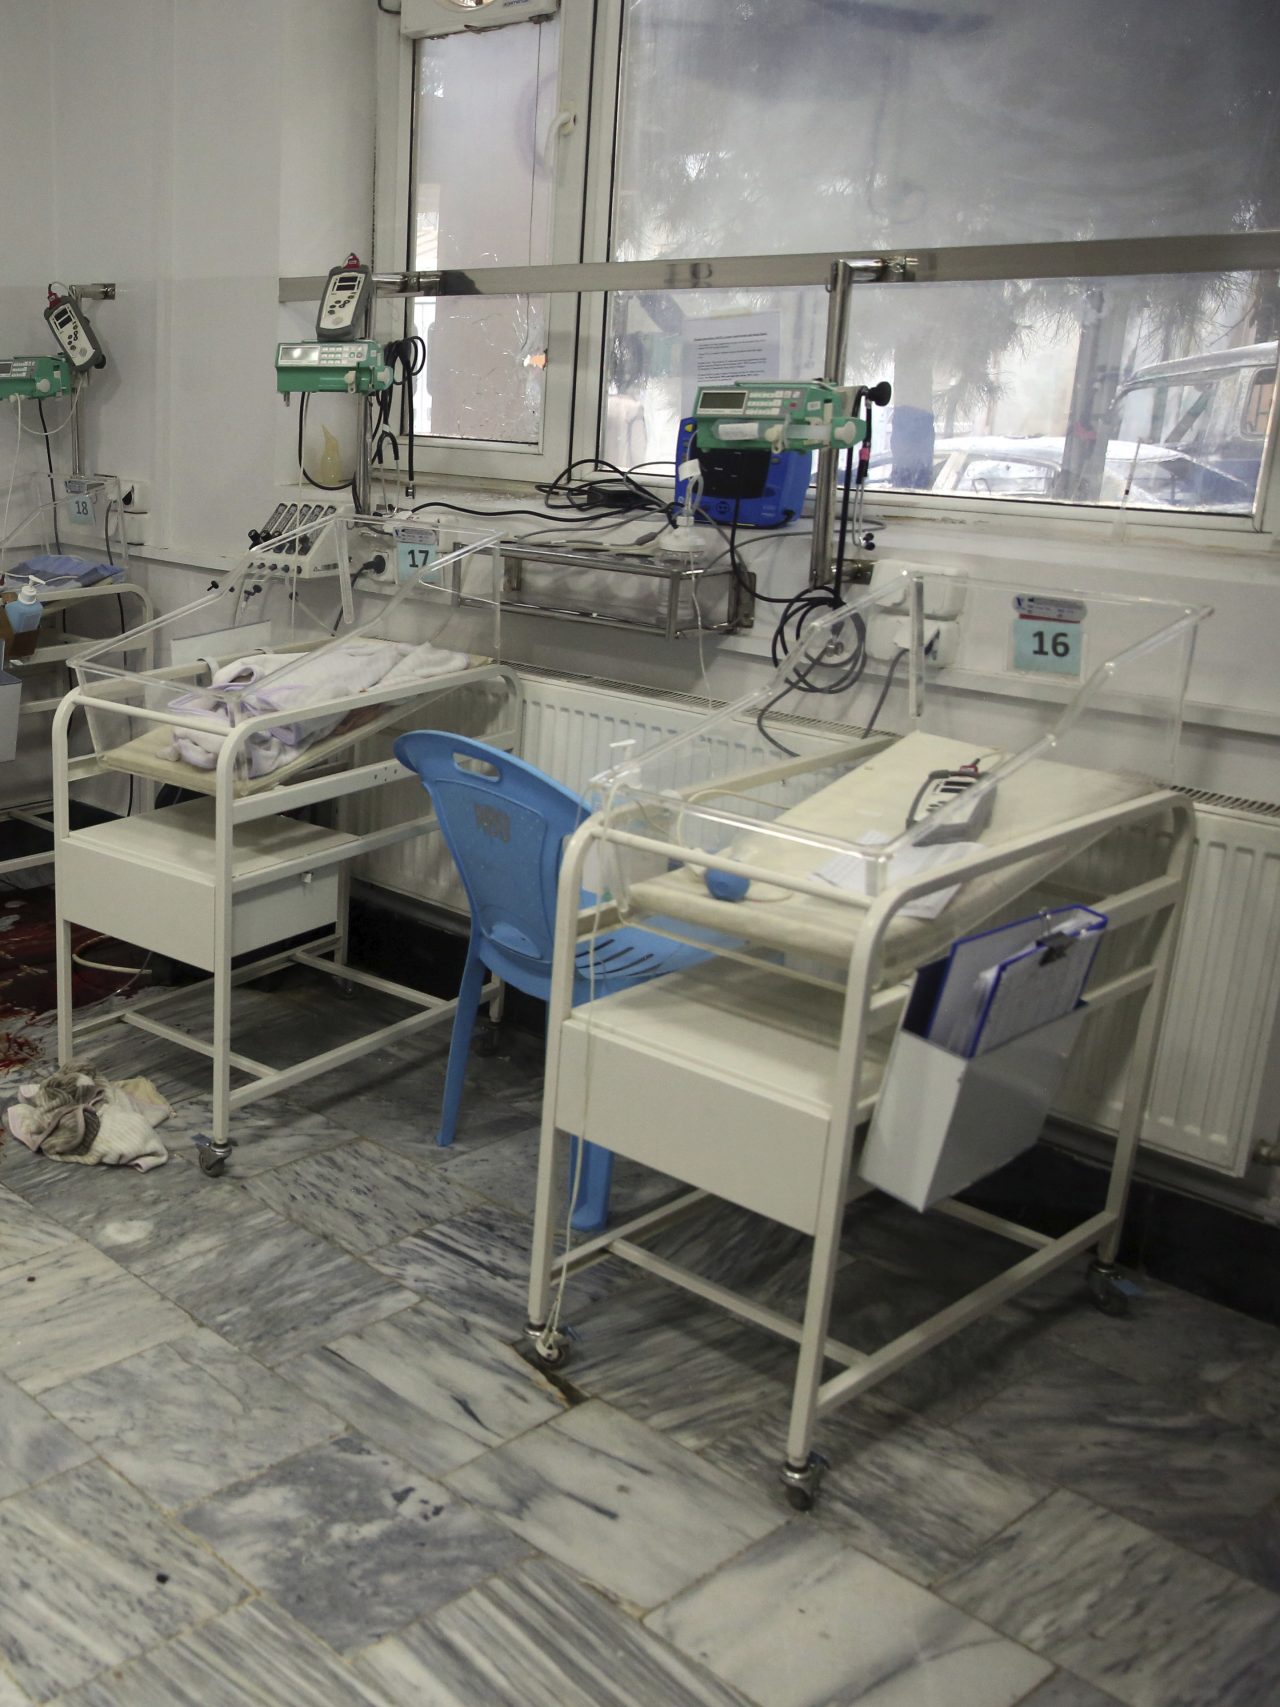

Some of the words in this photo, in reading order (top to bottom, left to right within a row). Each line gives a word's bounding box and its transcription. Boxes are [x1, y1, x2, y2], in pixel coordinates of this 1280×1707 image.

[75, 500, 89, 516] 18
[407, 549, 430, 568] 17
[1032, 630, 1070, 658] 16
